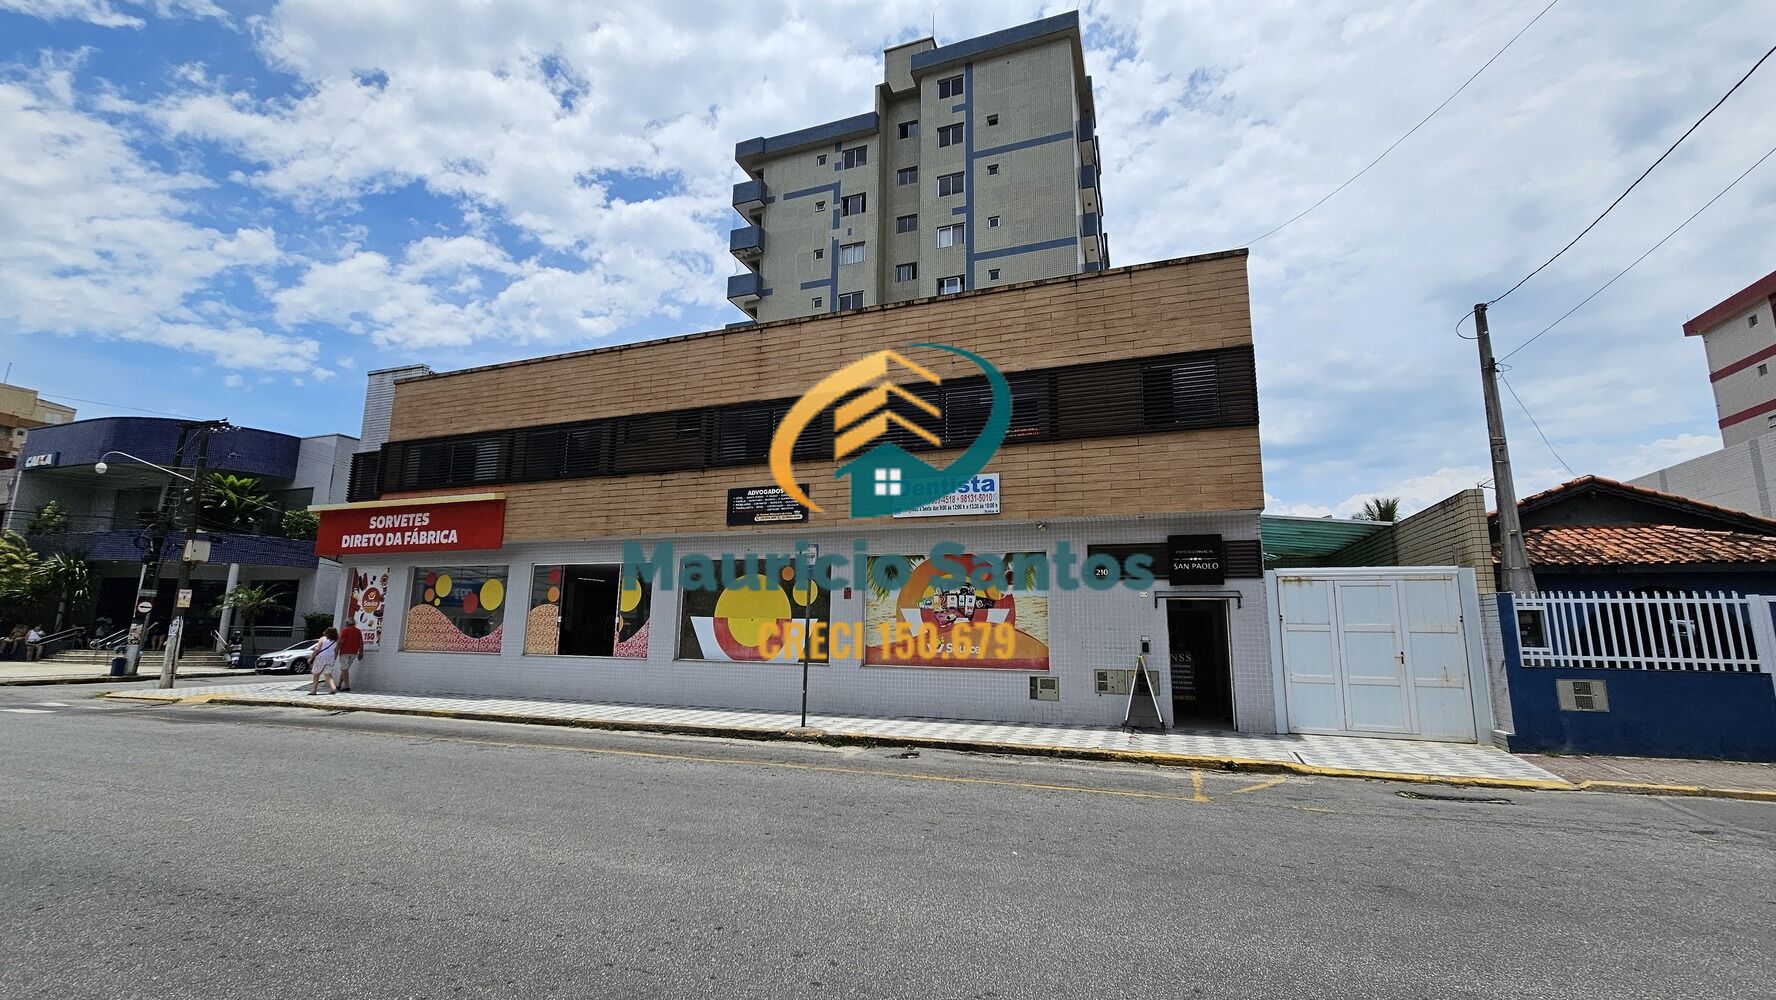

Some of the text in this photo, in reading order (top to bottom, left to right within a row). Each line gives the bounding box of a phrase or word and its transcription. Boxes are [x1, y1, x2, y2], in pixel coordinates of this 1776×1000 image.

[747, 487, 784, 496] ADVOGADOS
[369, 512, 430, 529] SORVETES
[341, 528, 458, 548] DIRETO DA FÁBRICA
[1173, 562, 1219, 570] SAN PAOLO
[1095, 568, 1109, 576] 210
